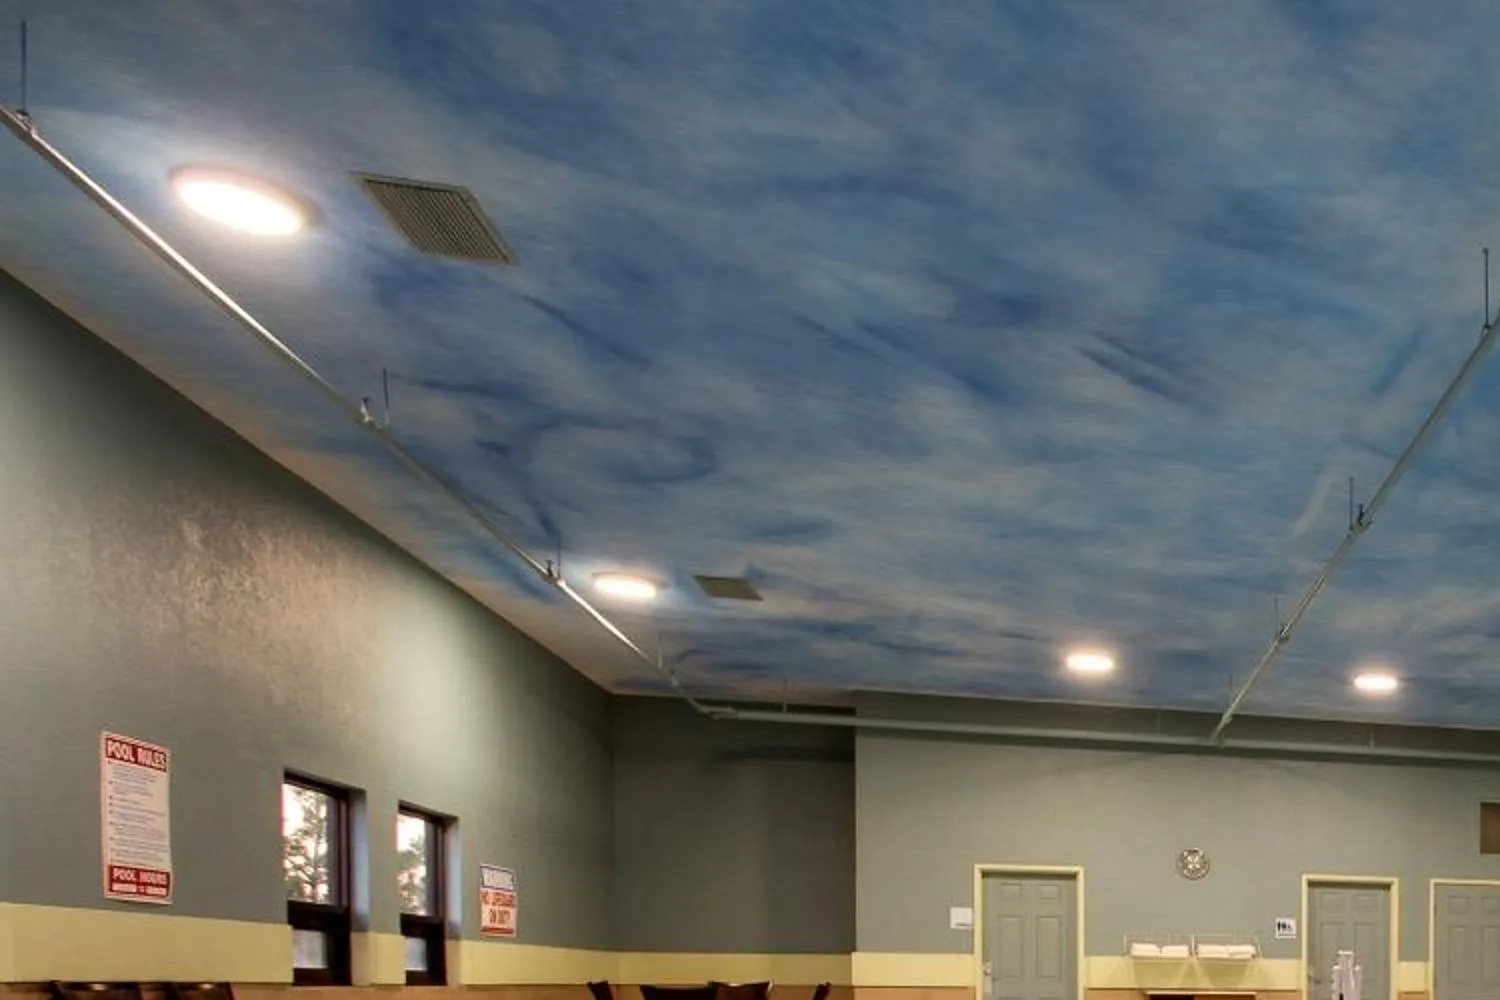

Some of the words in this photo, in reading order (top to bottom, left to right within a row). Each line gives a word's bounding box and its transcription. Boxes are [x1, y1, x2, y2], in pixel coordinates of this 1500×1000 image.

[107, 740, 136, 762] POOL
[136, 747, 166, 770] RULES
[113, 868, 137, 881] POOL
